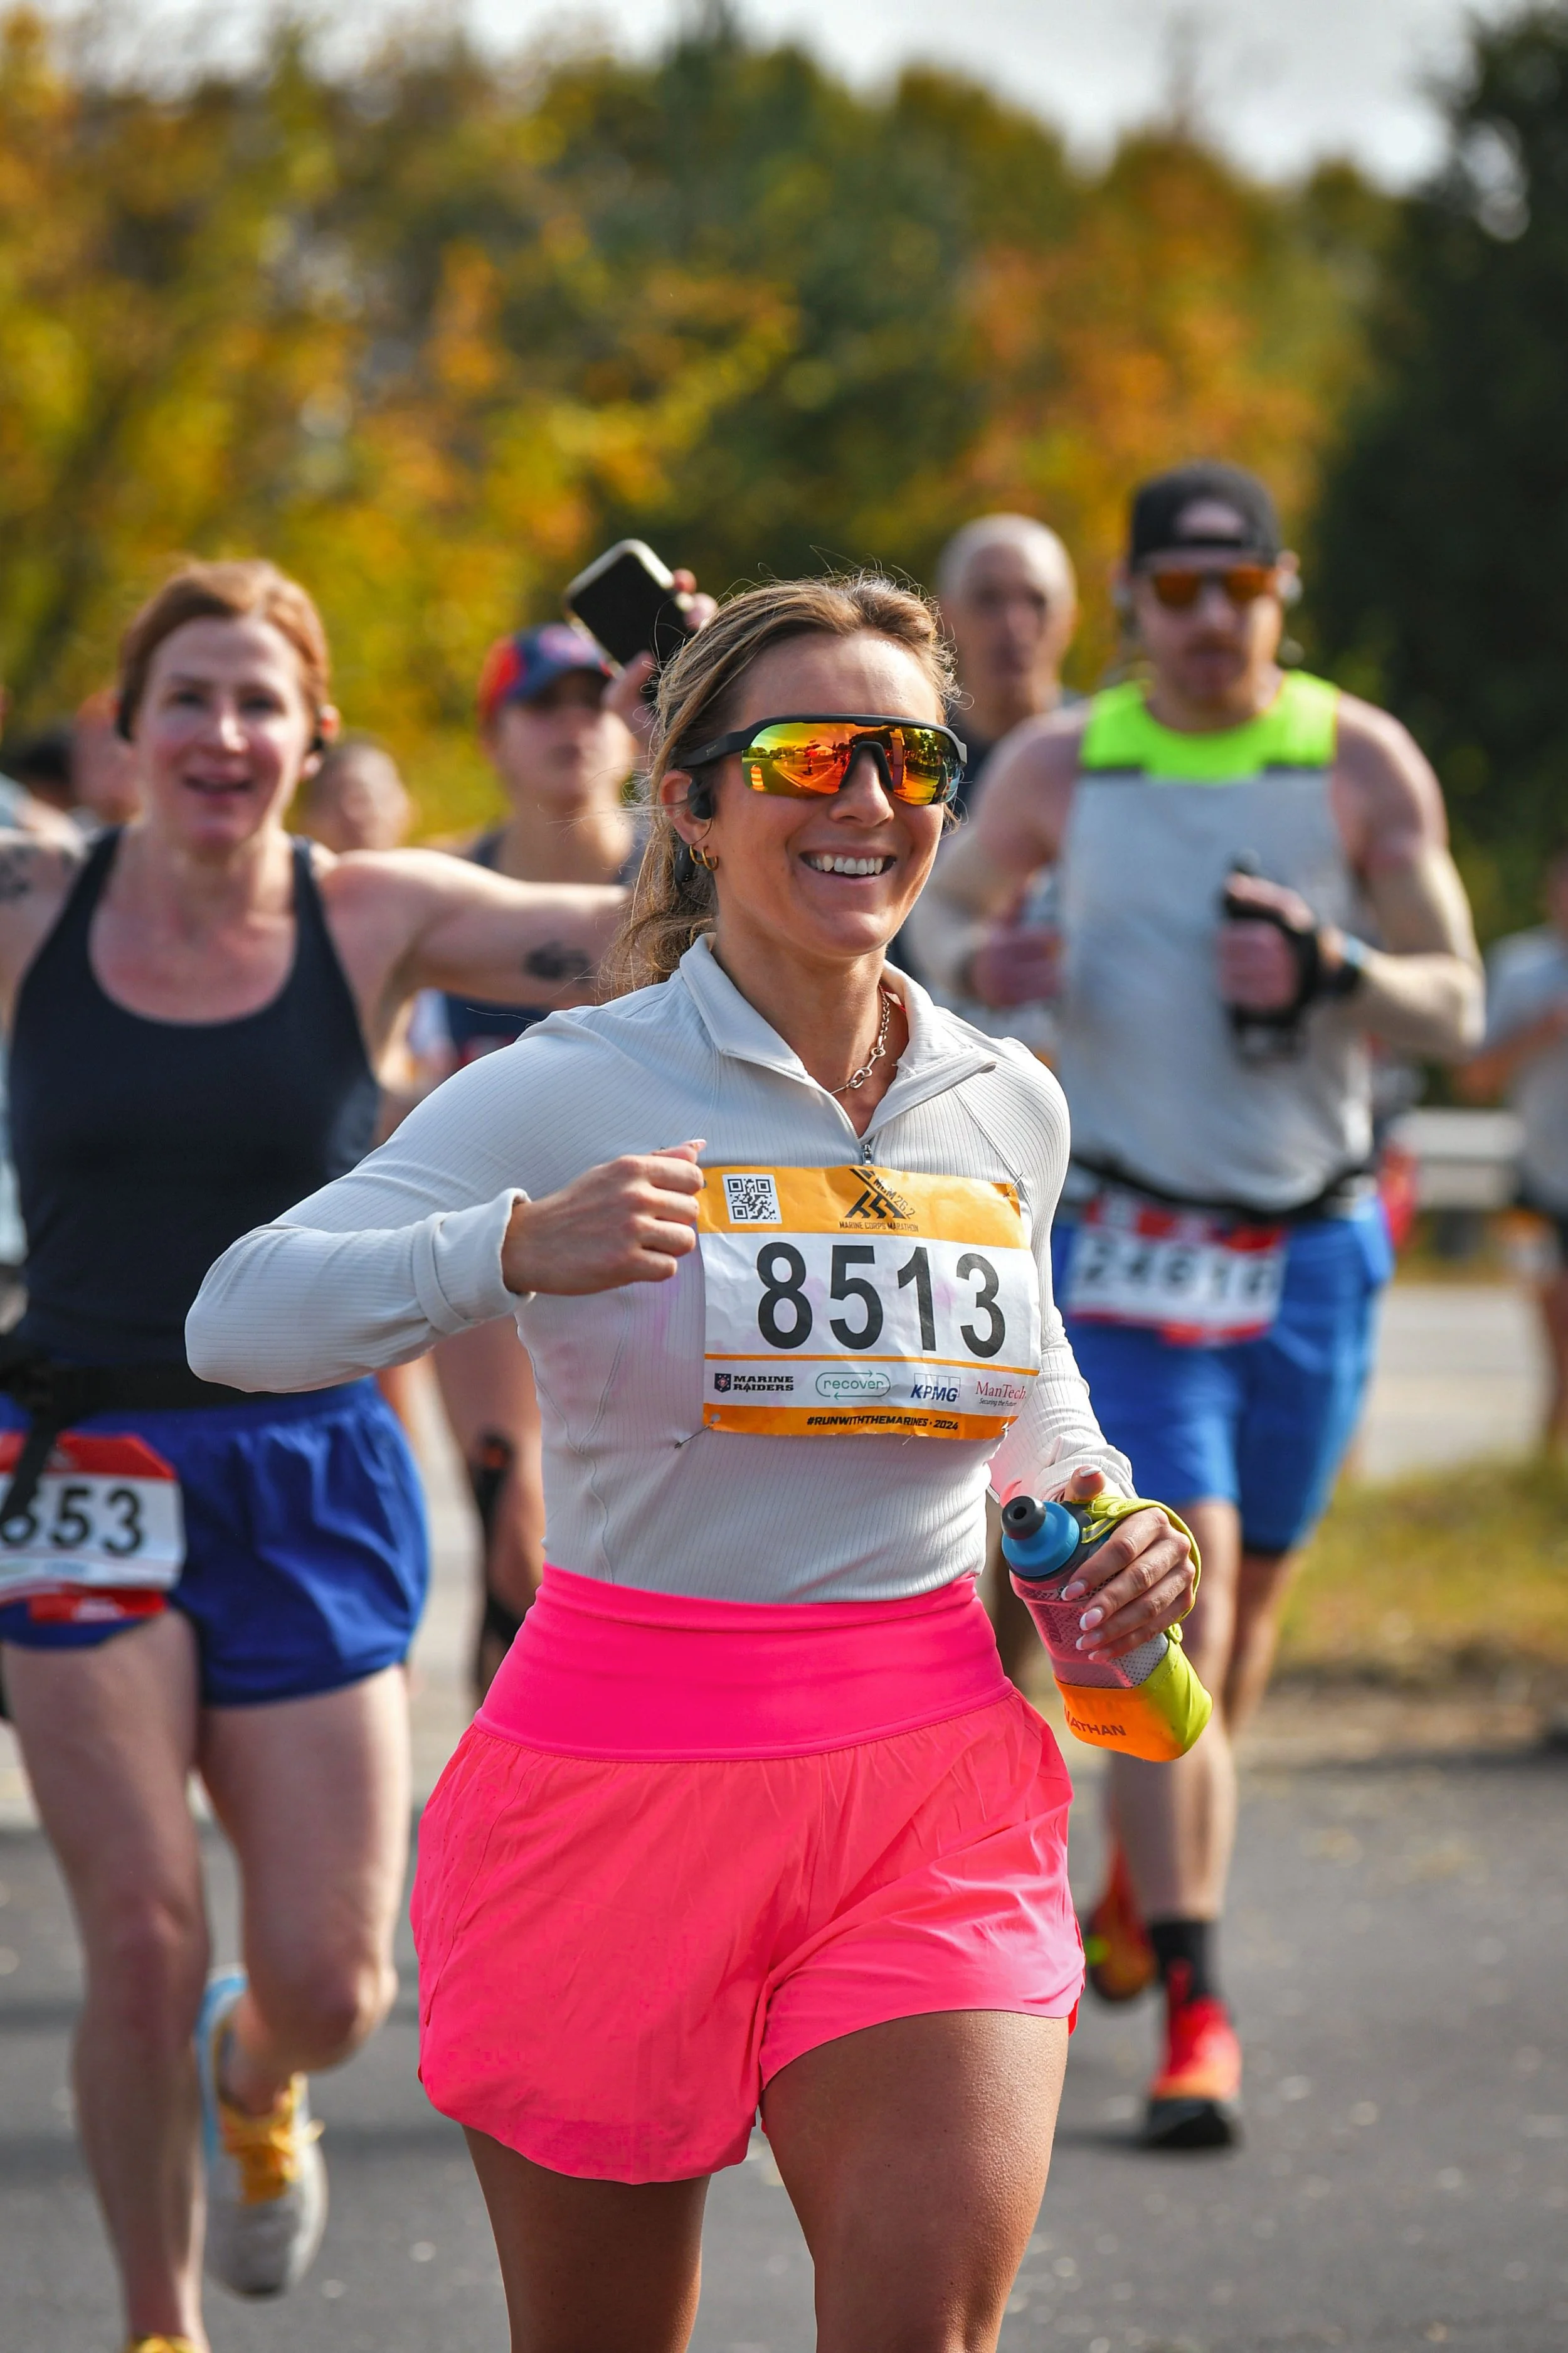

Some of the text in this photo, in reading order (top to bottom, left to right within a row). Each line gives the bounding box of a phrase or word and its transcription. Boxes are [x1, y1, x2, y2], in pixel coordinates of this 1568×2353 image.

[894, 1195, 916, 1219] 26.2
[887, 1222, 919, 1232] MARATHON
[756, 1241, 1005, 1359] 8513
[733, 1383, 794, 1392] RAIDERS
[824, 1380, 884, 1390] recover
[910, 1384, 958, 1403] KPMG
[979, 1398, 998, 1407] Securing
[807, 1415, 958, 1430] #RUNWITHTHEMARINES 2024
